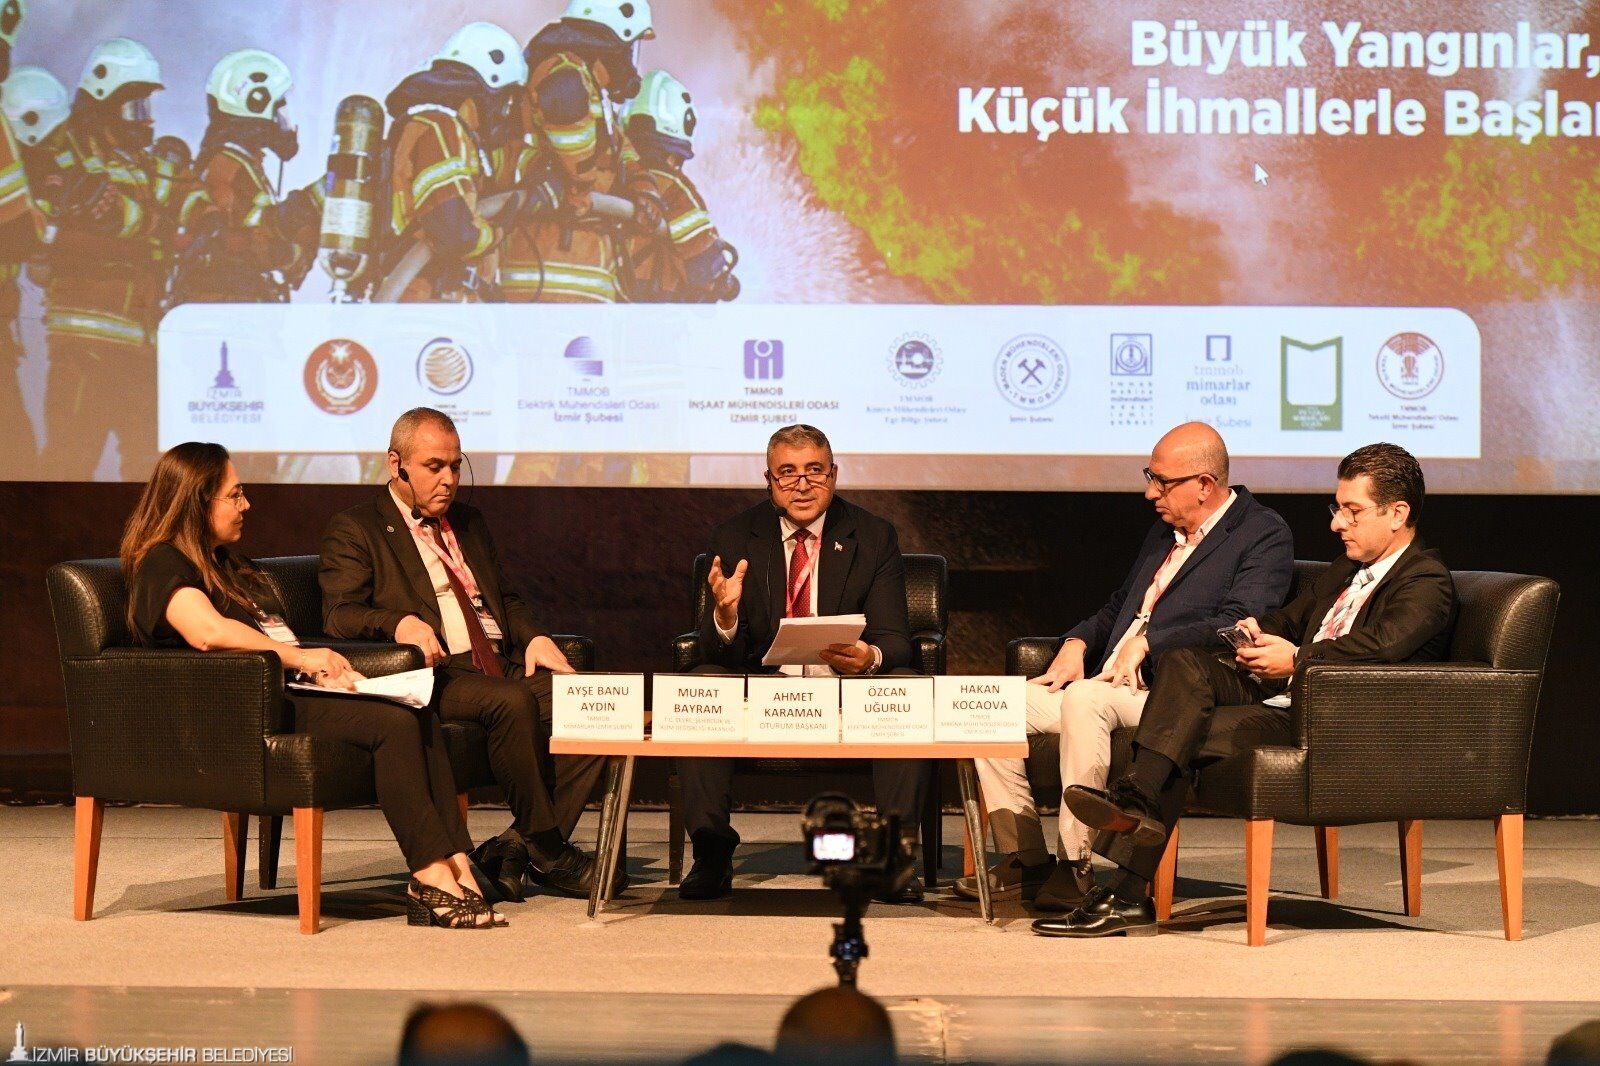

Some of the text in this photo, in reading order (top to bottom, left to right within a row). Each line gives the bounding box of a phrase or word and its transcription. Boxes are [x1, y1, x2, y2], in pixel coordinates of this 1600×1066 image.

[1131, 20, 1600, 76] Büyük Yangınlar,
[958, 86, 1129, 141] Küçük
[1147, 79, 1427, 135] İhmallerle
[1186, 378, 1251, 391] mimarlar
[567, 386, 610, 397] TMMOB
[744, 386, 784, 396] TMMOB
[517, 398, 555, 410] Elektrik
[628, 398, 660, 410] Odası
[1200, 393, 1237, 405] odası
[688, 399, 725, 411] İNŞAAT
[806, 400, 840, 410] ODASI
[553, 410, 624, 424] İzmir Şubesi
[730, 412, 798, 425] İZMİR ŞUBESİ
[567, 685, 630, 698] AYŞE BANU
[677, 687, 720, 698] MURAT
[868, 686, 907, 697] ÖZCAN
[960, 684, 1001, 694] HAKAN
[773, 692, 814, 702] AHMET
[580, 702, 616, 712] AYDIN
[673, 703, 722, 714] BAYRAM
[864, 701, 911, 713] UĞURLU
[952, 699, 1008, 710] KOCAOVA
[764, 708, 822, 718] KARAMAN
[759, 722, 793, 730] OTURUM
